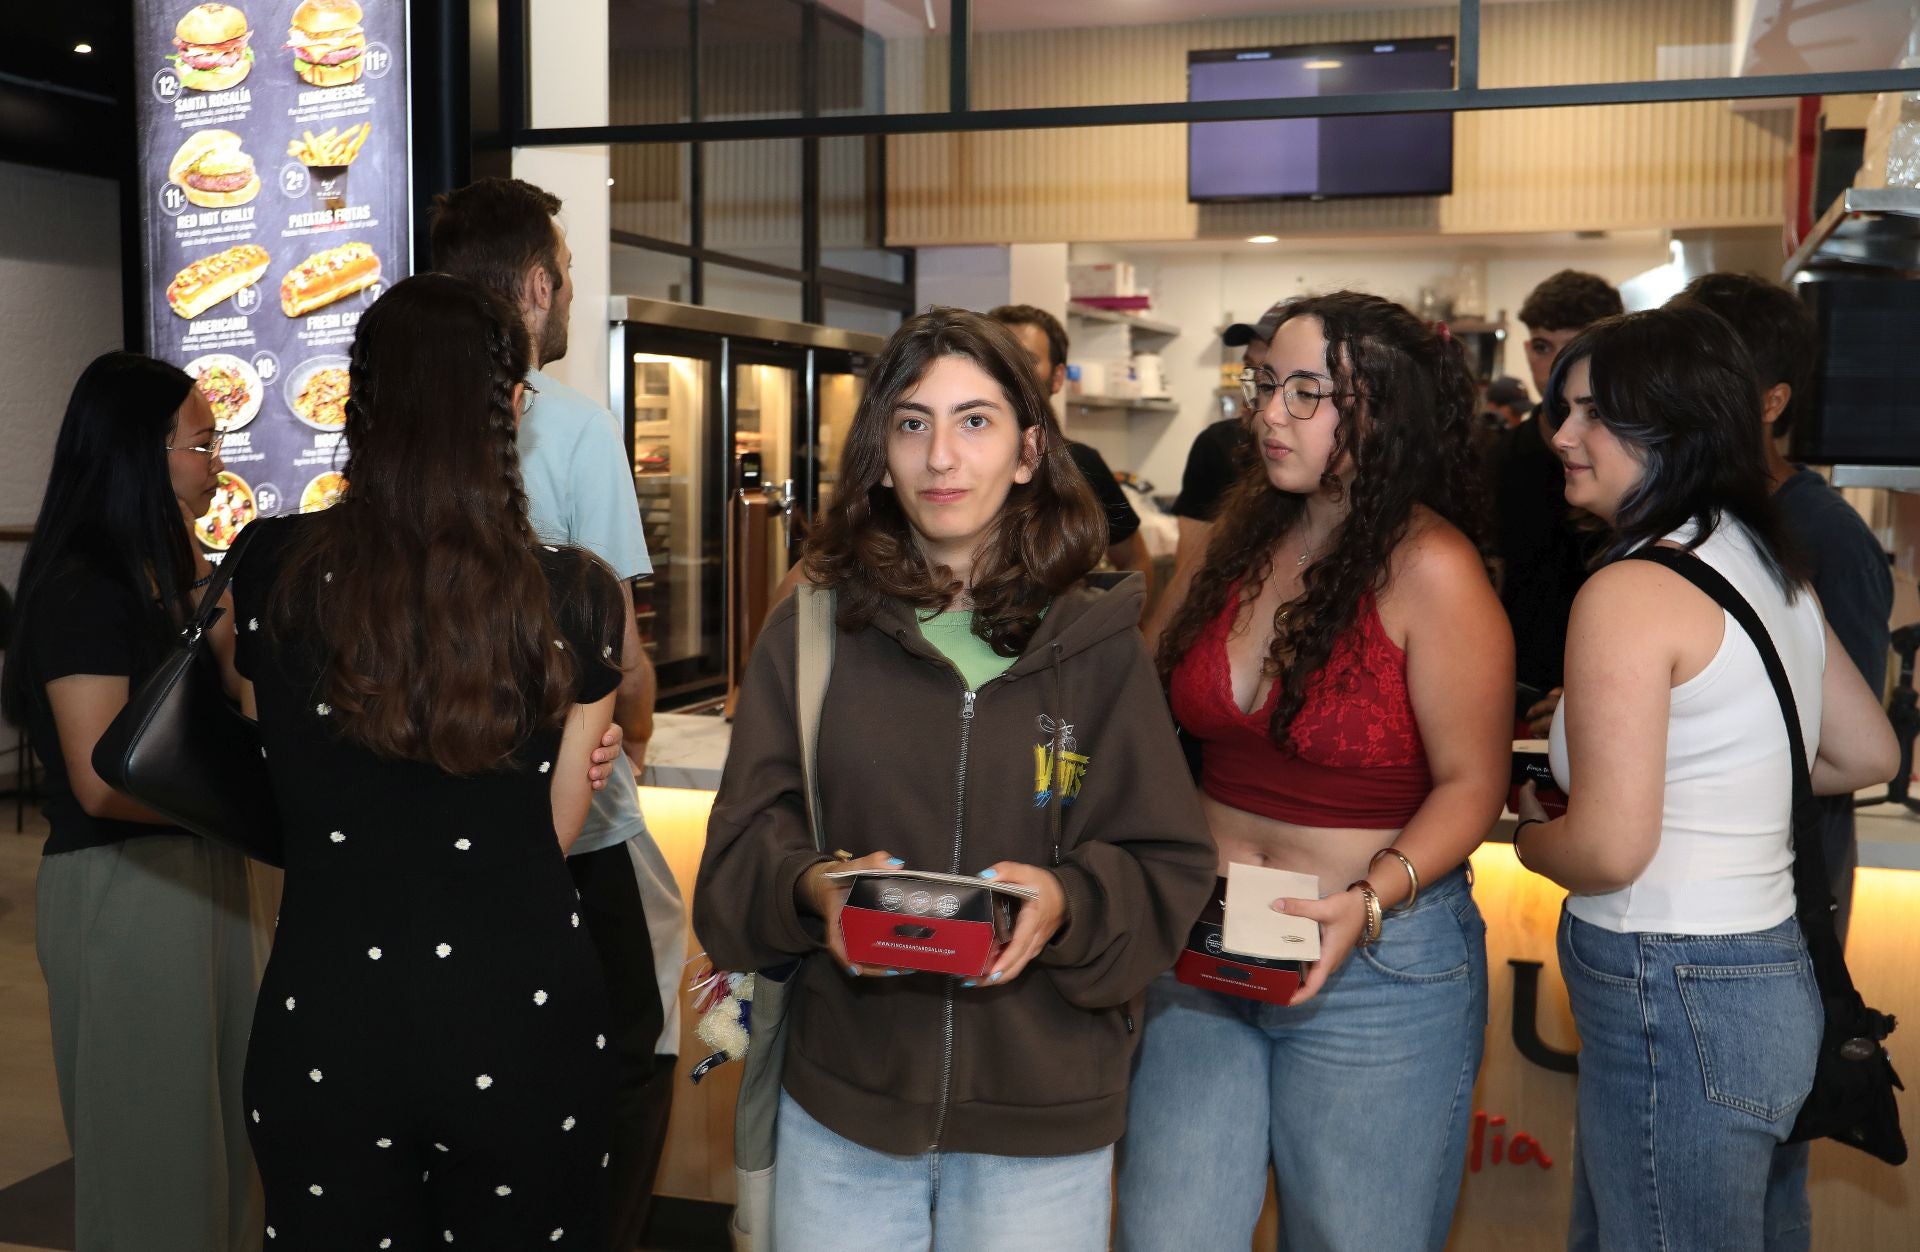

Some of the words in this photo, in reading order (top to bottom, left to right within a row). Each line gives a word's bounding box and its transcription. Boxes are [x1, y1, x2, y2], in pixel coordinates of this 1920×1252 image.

[175, 96, 207, 113] SANTA
[177, 213, 198, 229] RED
[199, 210, 220, 226] HOT
[221, 206, 255, 224] CHILLY
[288, 209, 333, 228] PATATAS
[334, 204, 371, 222] FRITAS
[188, 315, 248, 336] AMERICANO
[306, 313, 340, 331] FRESH
